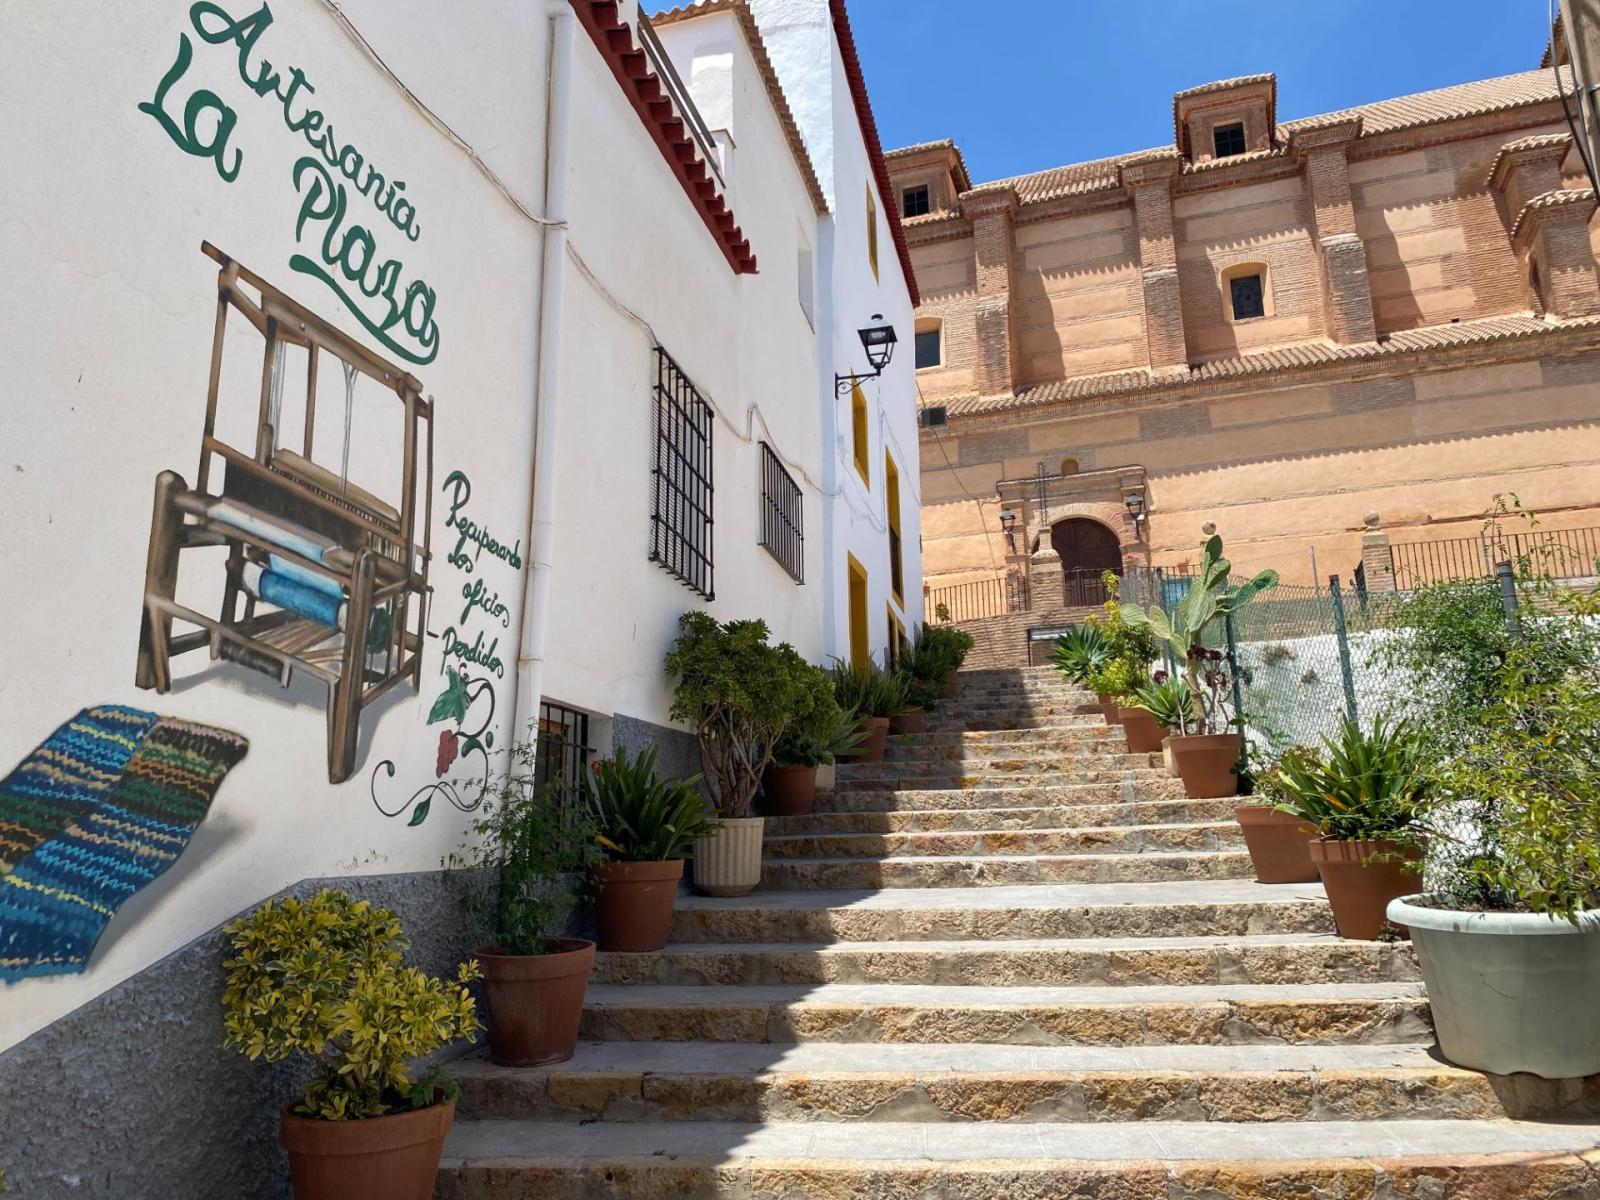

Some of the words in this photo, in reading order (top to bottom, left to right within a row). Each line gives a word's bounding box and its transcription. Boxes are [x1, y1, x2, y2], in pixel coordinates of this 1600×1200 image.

[138, 32, 243, 183] La
[289, 156, 440, 365] Plaza
[189, 0, 420, 241] Artesanía
[442, 470, 521, 570] Recuperando
[440, 626, 504, 679] Perdidos
